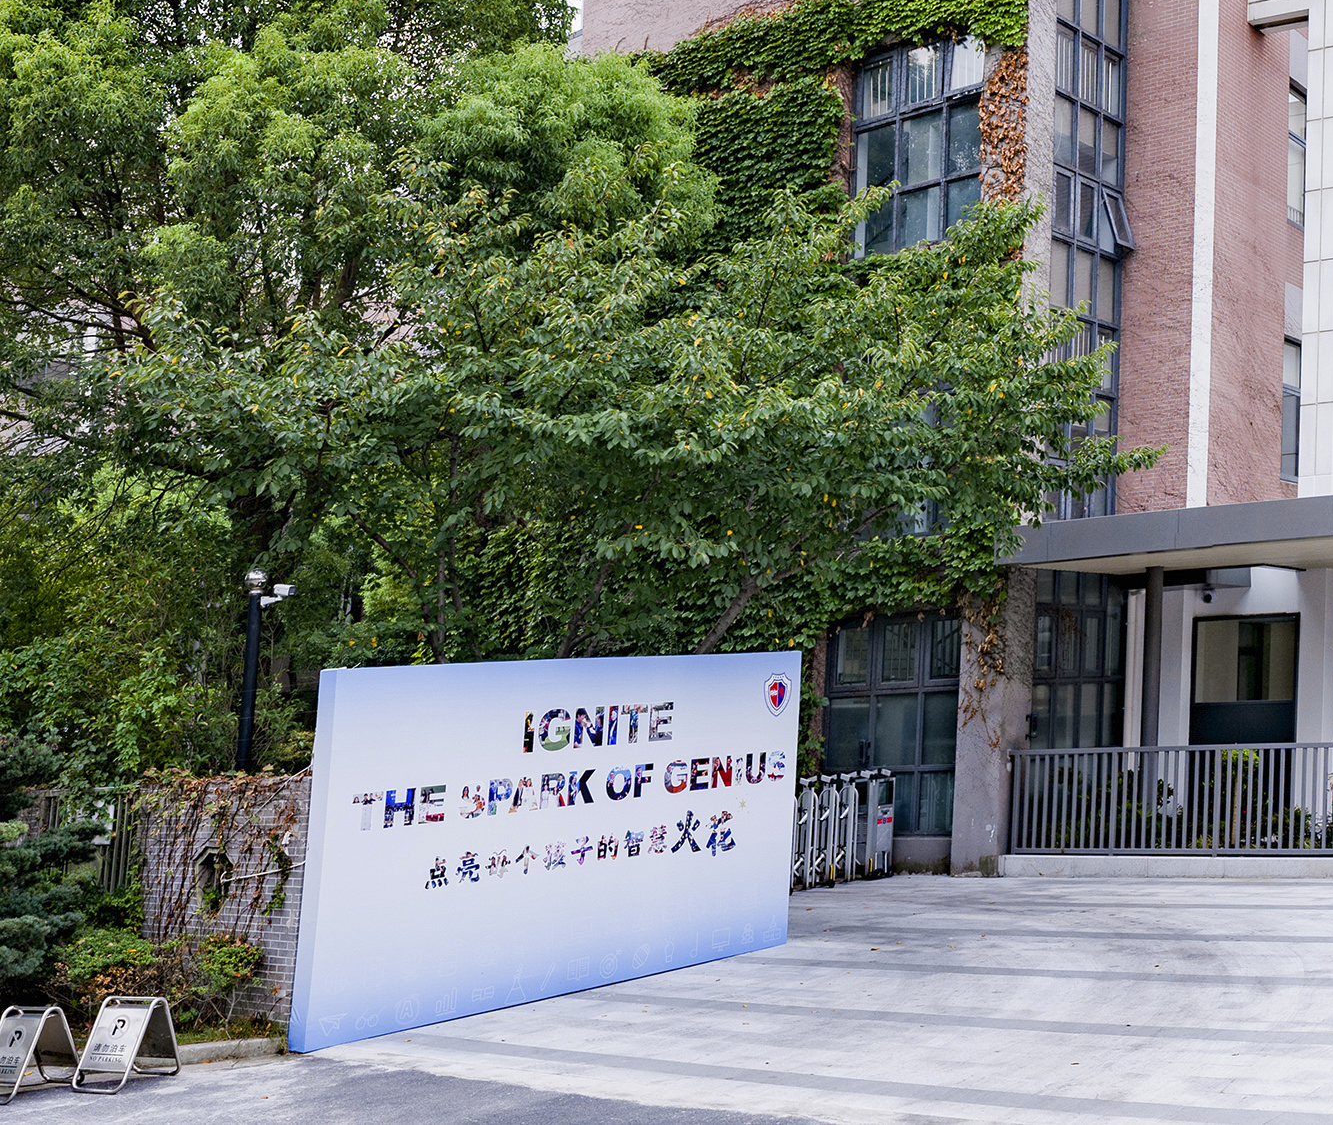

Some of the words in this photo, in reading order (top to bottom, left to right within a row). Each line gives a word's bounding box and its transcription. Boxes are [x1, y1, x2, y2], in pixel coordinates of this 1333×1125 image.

[522, 702, 674, 753] IGNITE
[352, 785, 448, 831] THE
[459, 769, 596, 819] SPARK
[606, 763, 654, 801] OF
[664, 750, 786, 794] GENIUS
[424, 810, 736, 889] 点亮每个孩子的智慧火花
